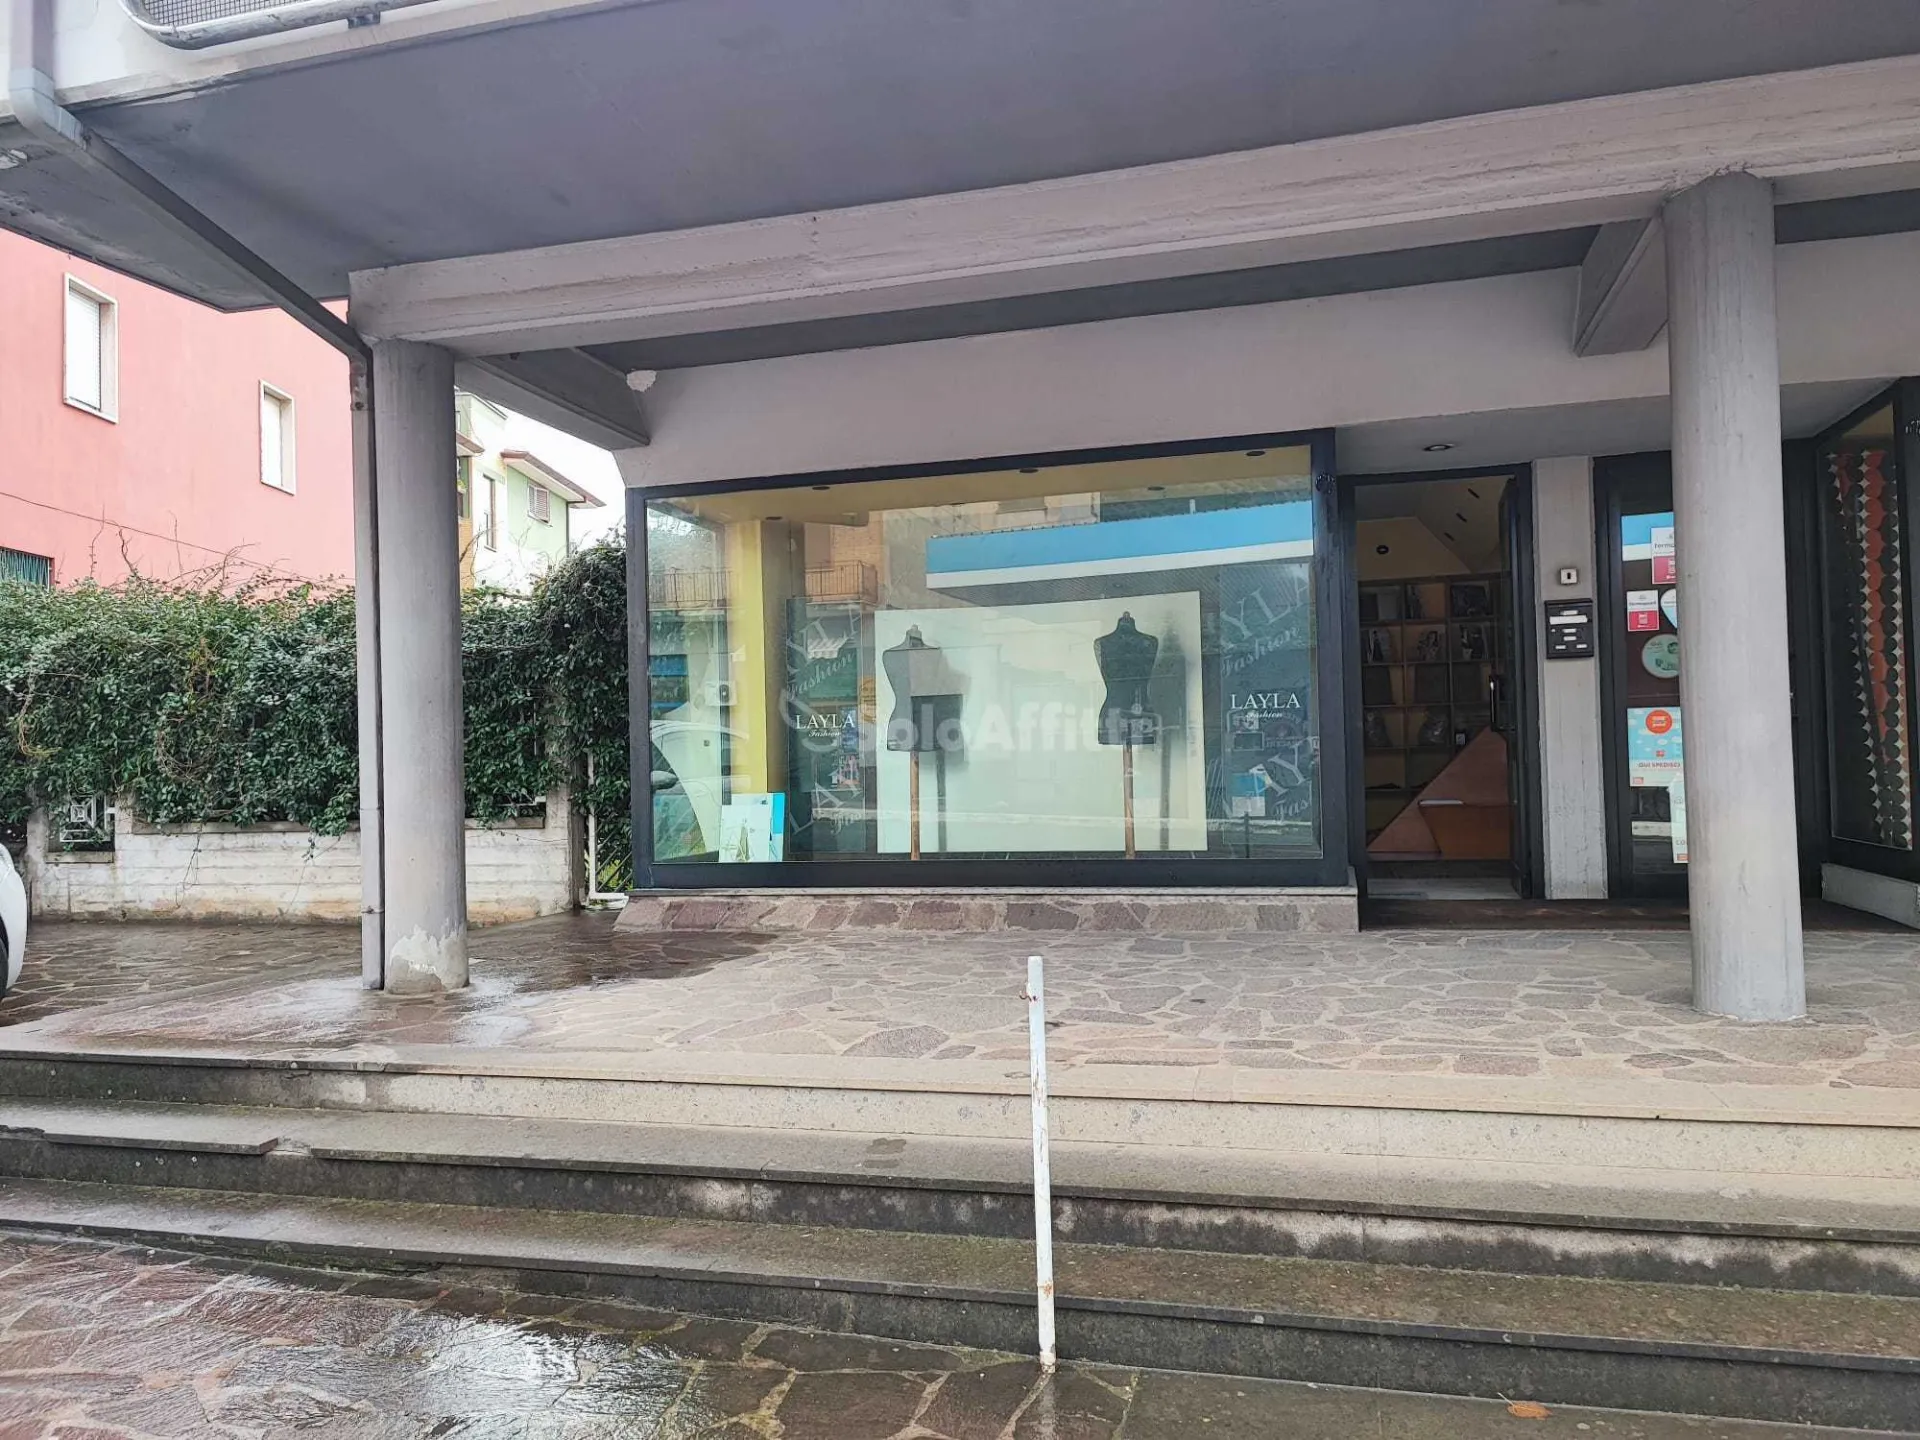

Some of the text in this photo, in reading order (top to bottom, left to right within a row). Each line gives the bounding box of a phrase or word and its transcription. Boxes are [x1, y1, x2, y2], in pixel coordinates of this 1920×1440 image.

[1220, 626, 1301, 678] Fashion
[787, 651, 855, 701] Fashion
[1230, 692, 1301, 710] LAYLA
[795, 713, 856, 730] LAYLA
[808, 729, 841, 737] Fashion
